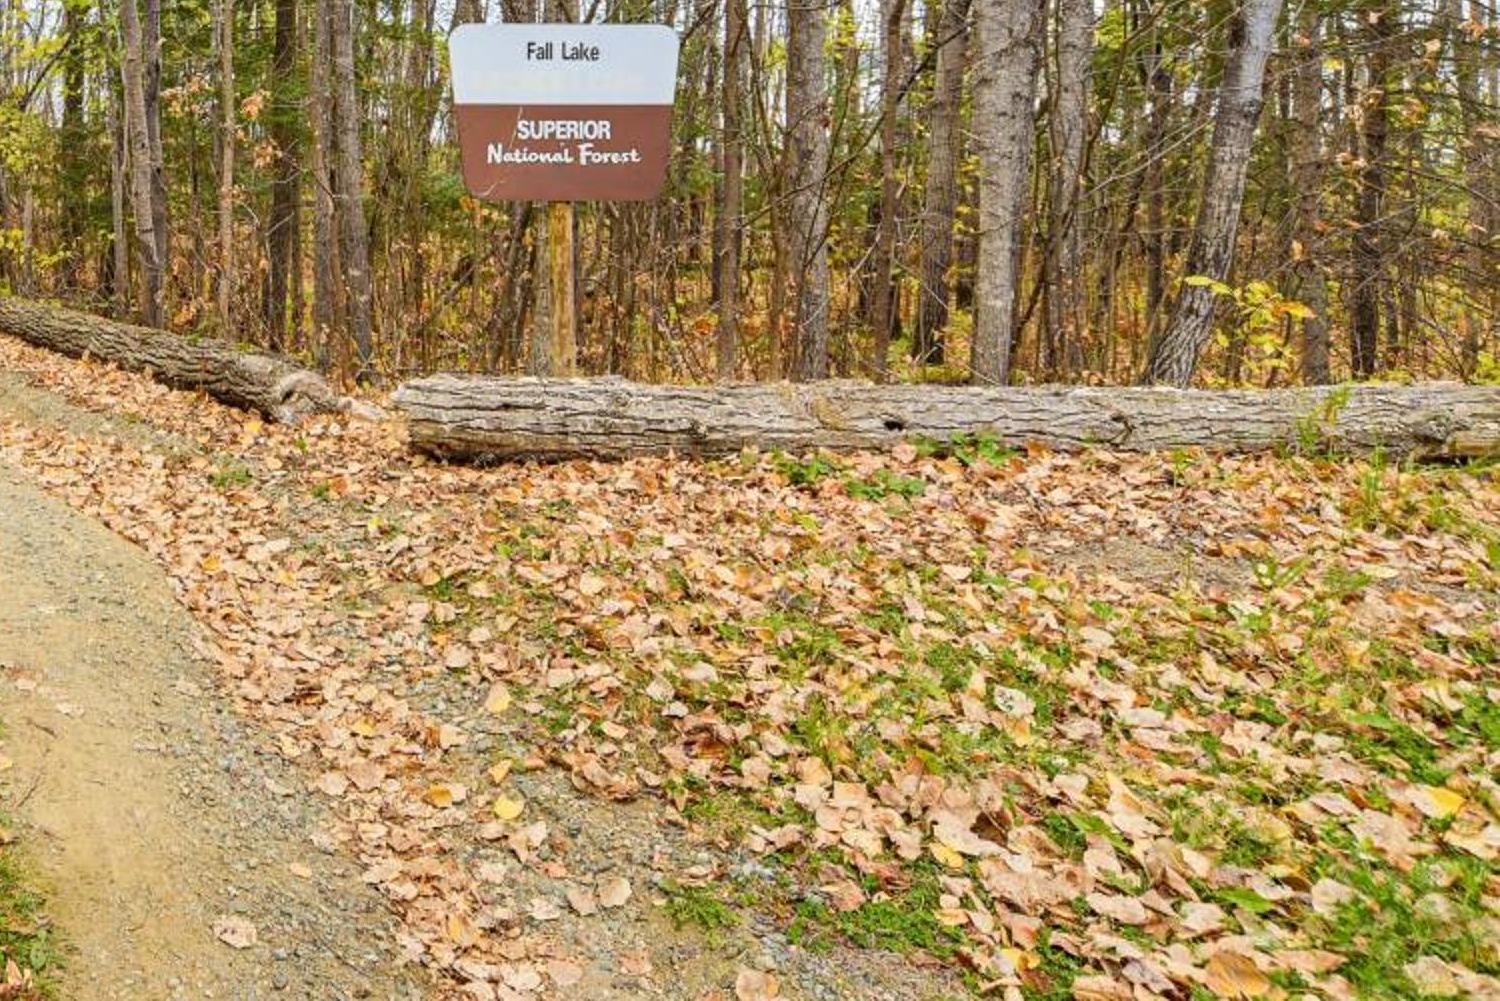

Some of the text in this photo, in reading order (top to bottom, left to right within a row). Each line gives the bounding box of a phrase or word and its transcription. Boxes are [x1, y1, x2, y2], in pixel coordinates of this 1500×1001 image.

[527, 42, 600, 61] Fall Lake
[517, 120, 611, 140] SUPERIOR
[487, 143, 641, 165] National Forest
